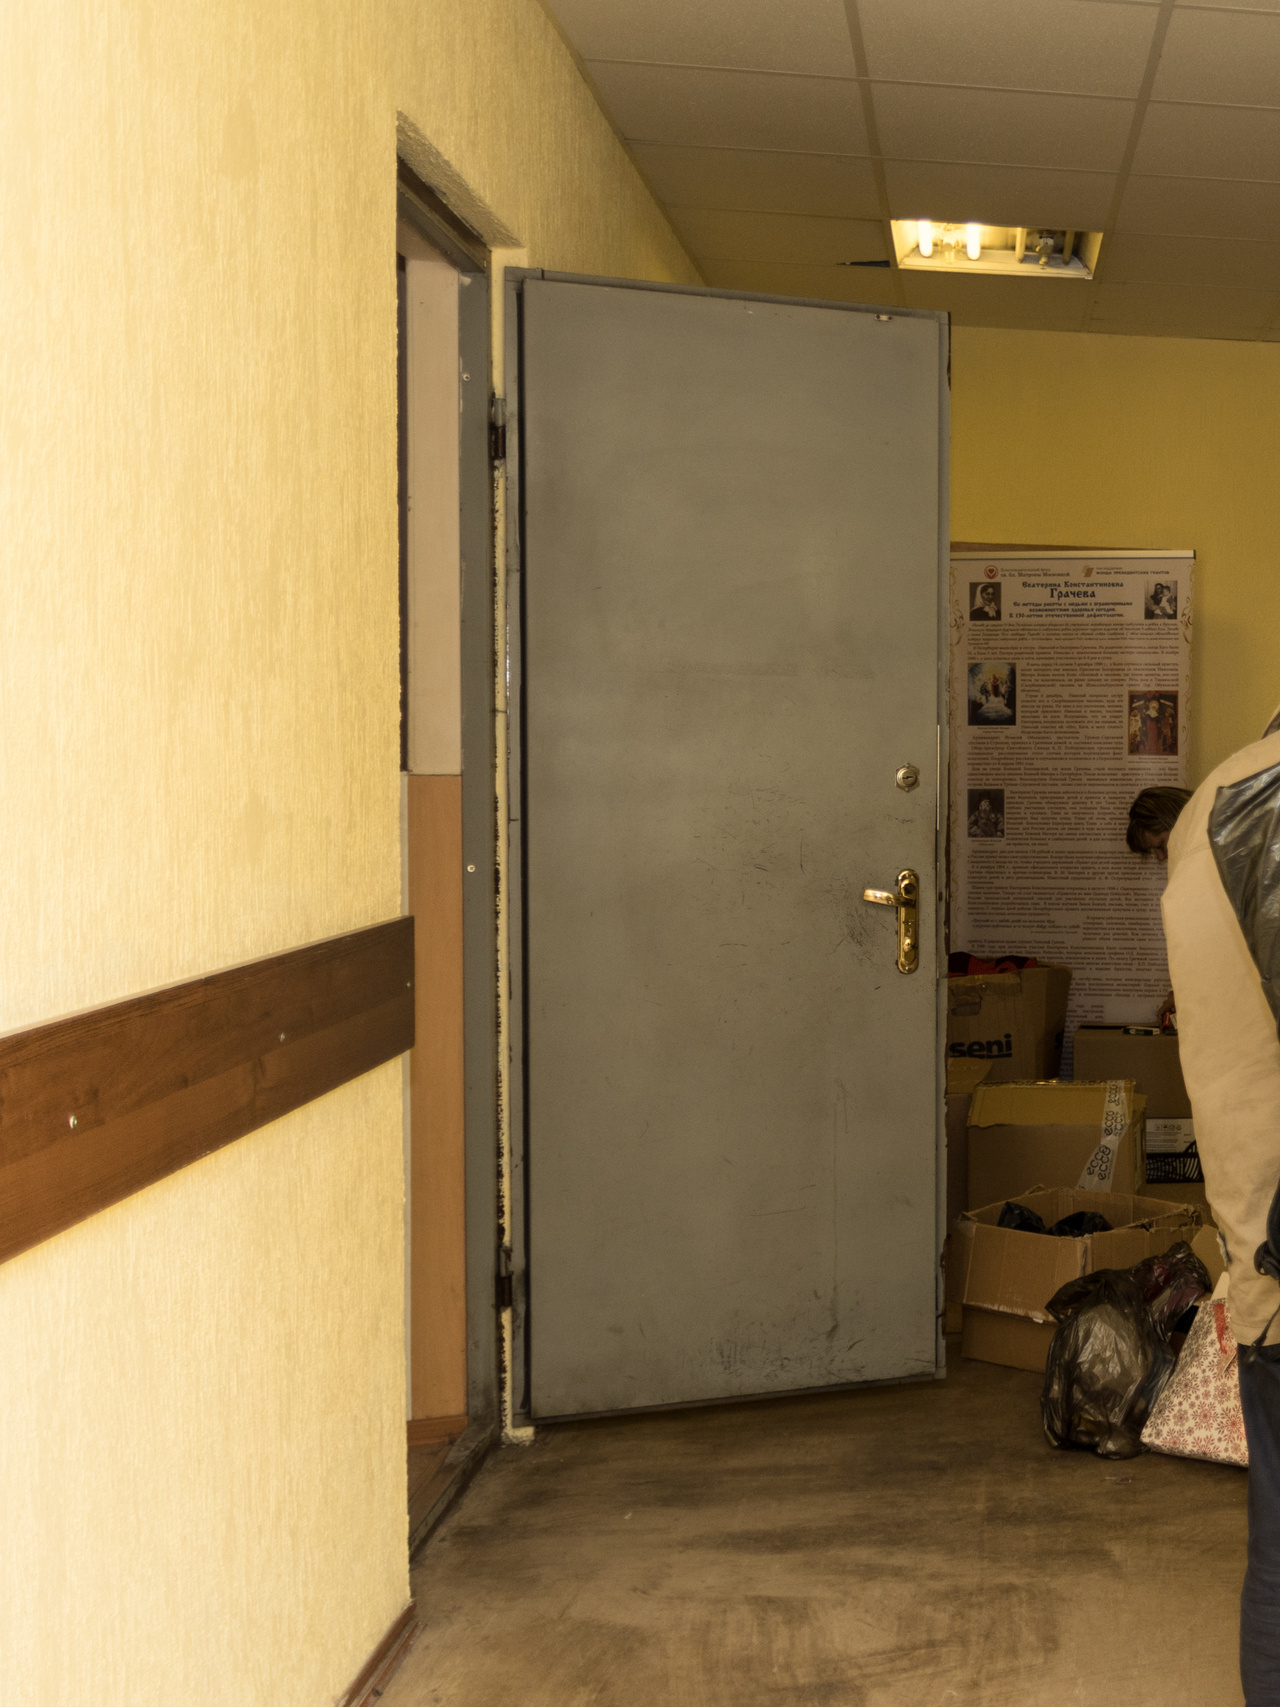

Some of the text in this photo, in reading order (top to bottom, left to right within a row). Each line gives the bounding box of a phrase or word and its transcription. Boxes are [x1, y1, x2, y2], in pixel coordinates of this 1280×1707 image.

[1050, 588, 1096, 601] Грачева
[949, 1033, 1012, 1059] seni
[1104, 1110, 1114, 1136] ecco
[1086, 1145, 1107, 1176] ecco
[1098, 1146, 1111, 1181] ecco
